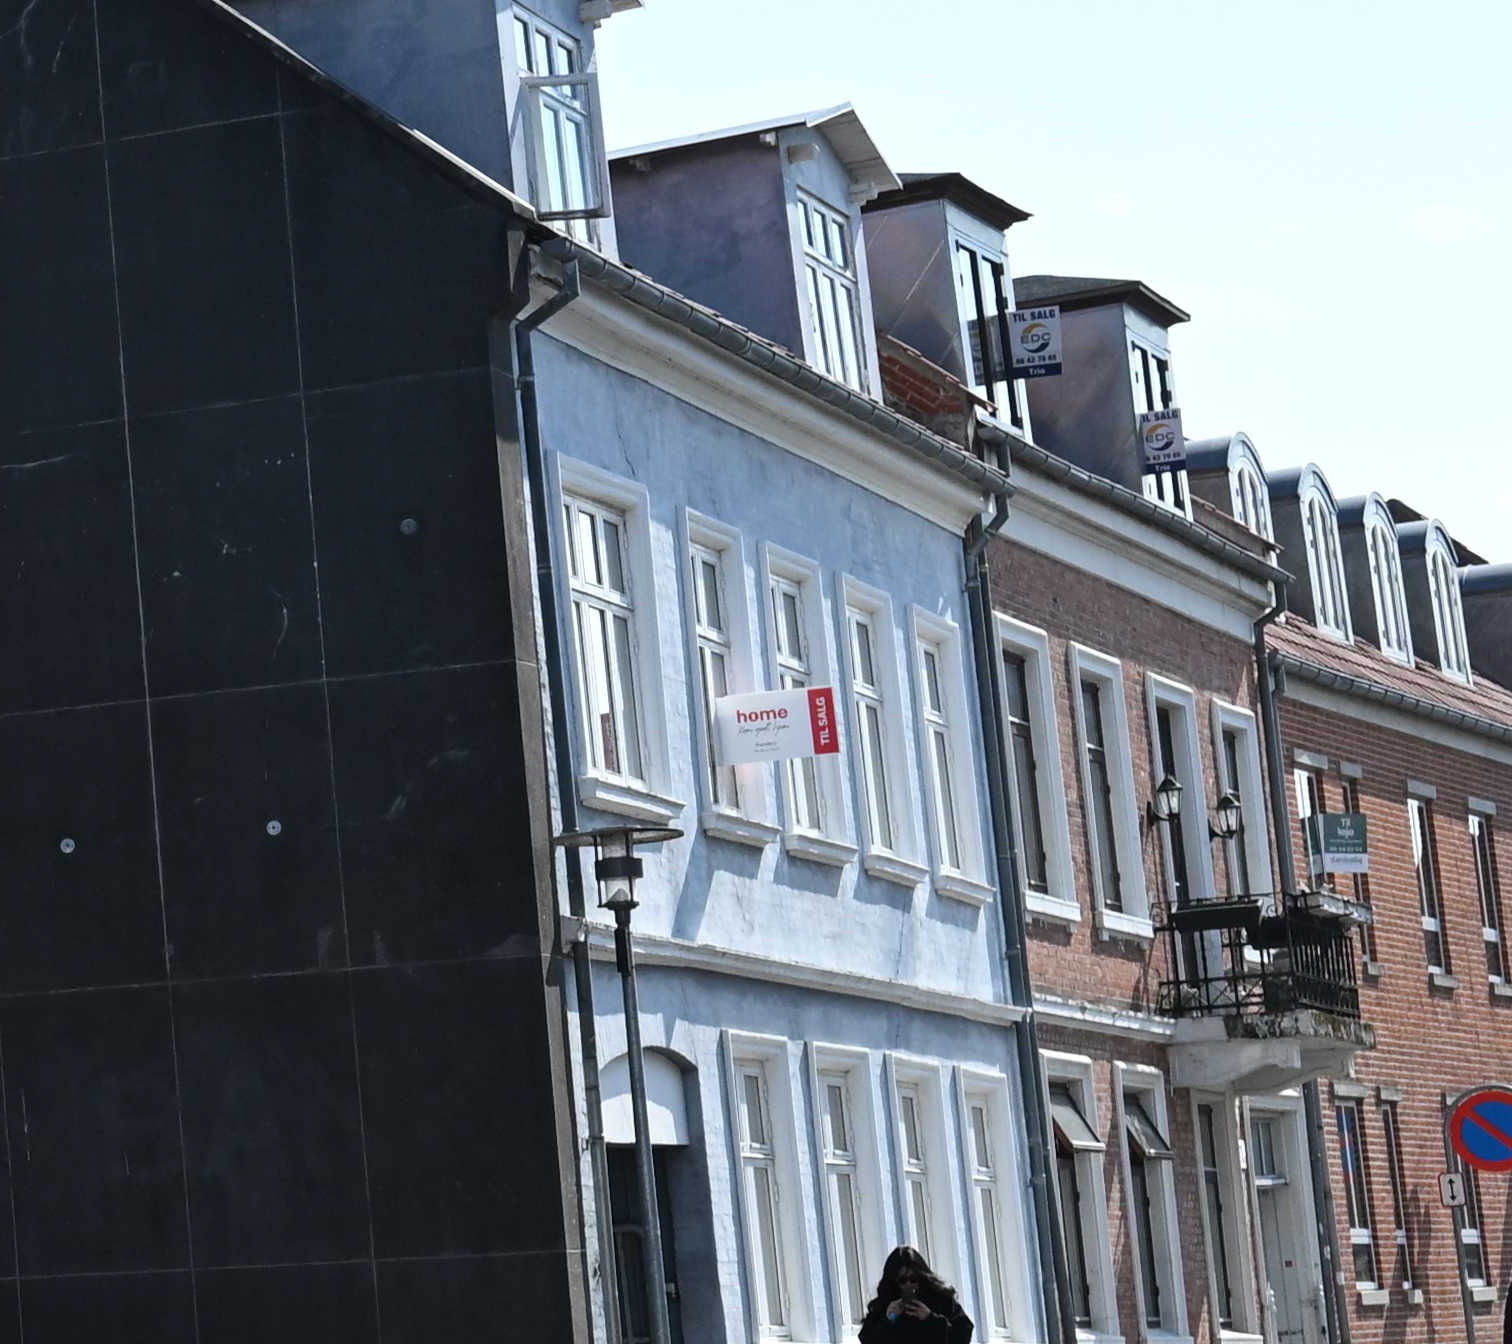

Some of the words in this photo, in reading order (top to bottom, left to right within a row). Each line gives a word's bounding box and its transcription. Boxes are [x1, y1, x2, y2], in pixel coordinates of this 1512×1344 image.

[1013, 312, 1026, 323] TIL
[1030, 309, 1056, 321] SALG
[1020, 332, 1052, 345] EDC
[1154, 410, 1179, 422] SALG
[736, 708, 789, 724] home
[816, 696, 828, 726] SALG
[819, 727, 830, 745] TIL
